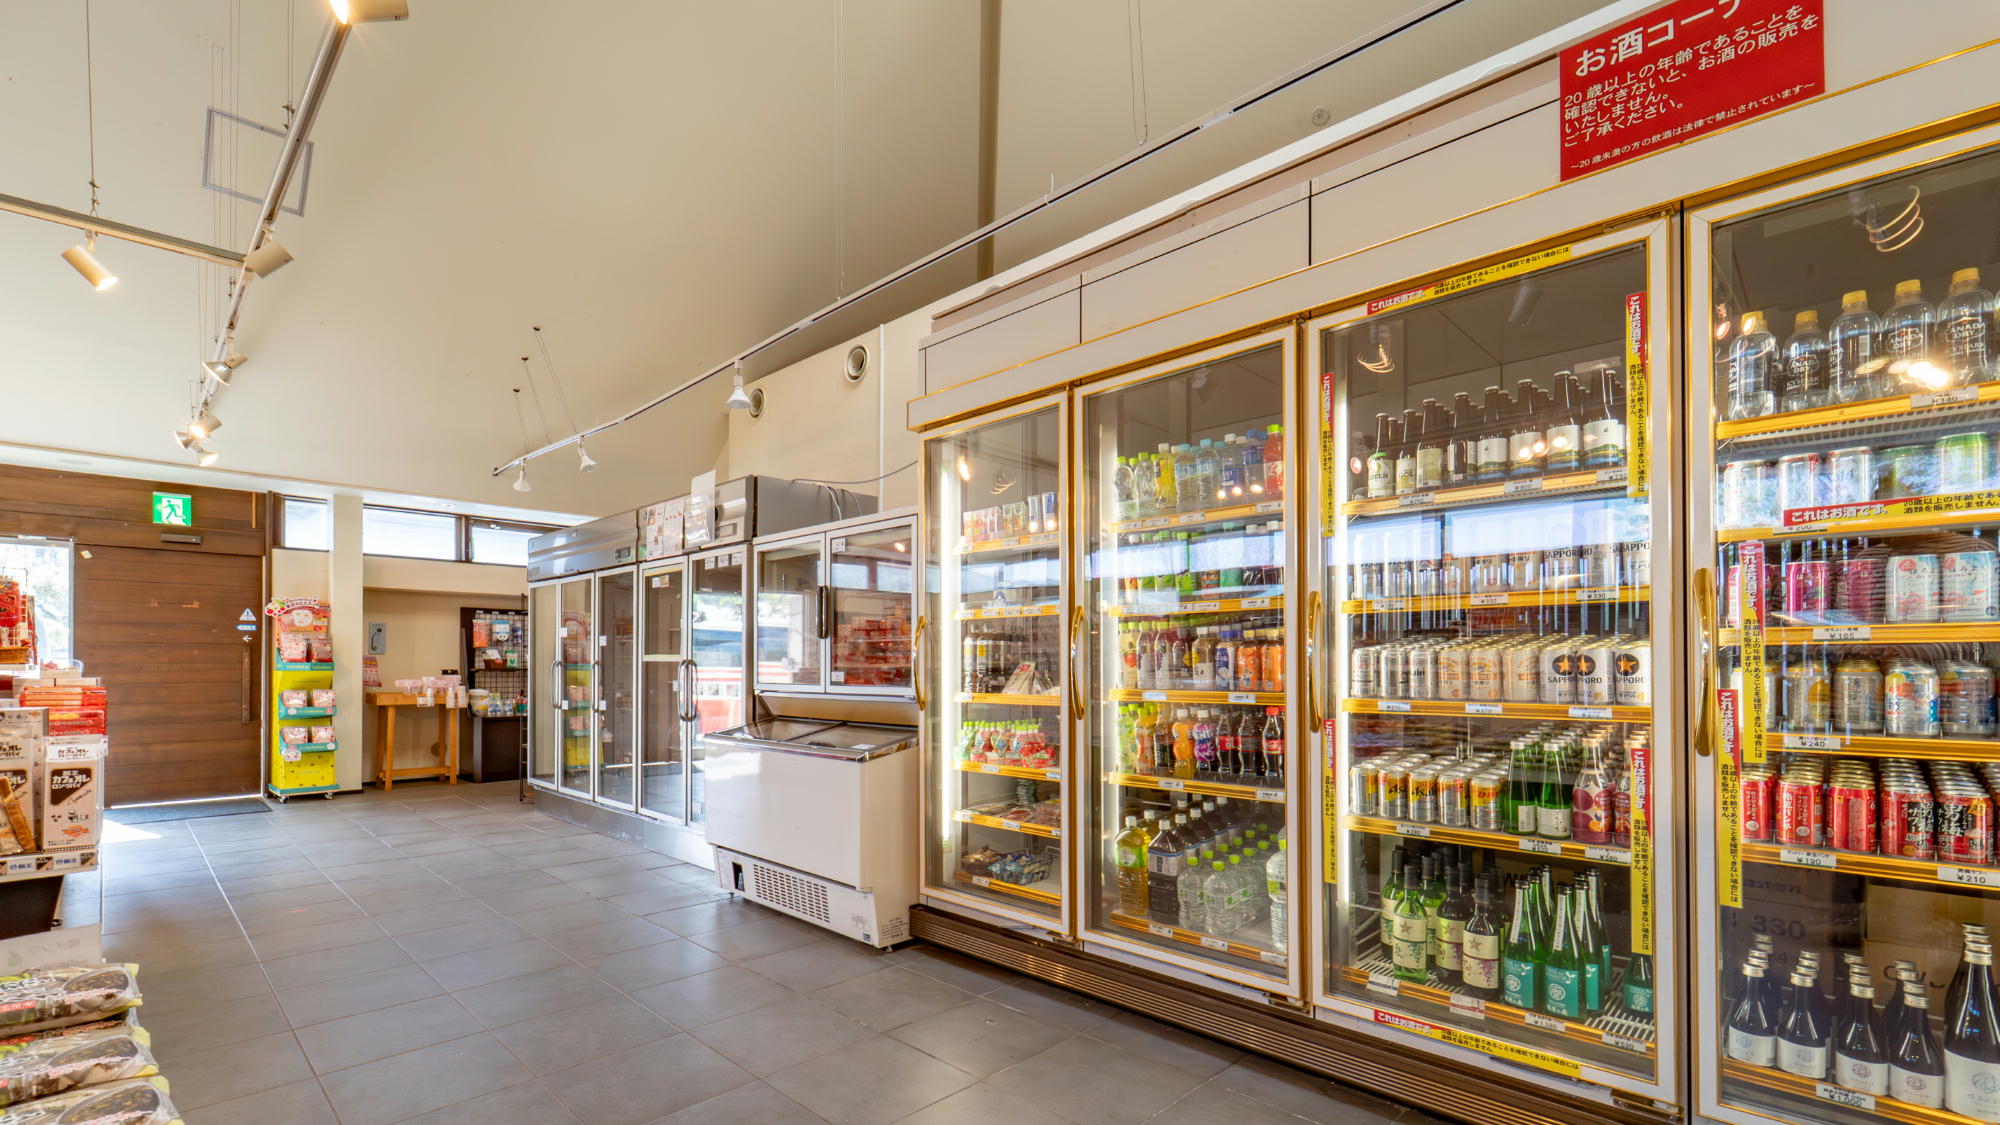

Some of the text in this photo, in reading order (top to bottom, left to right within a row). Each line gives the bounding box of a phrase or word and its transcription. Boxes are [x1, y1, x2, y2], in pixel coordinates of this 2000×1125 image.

[1564, 100, 1683, 147] ご了承ください。
[1565, 92, 1669, 134] いたしません。
[1791, 503, 1889, 522] これはお酒です。
[1744, 546, 1757, 610] これはお酒です。
[1720, 692, 1734, 758] これはお酒です。
[52, 774, 91, 784] カフェオレ
[1942, 804, 1964, 837] 男梅
[1956, 874, 1986, 884] ¥210
